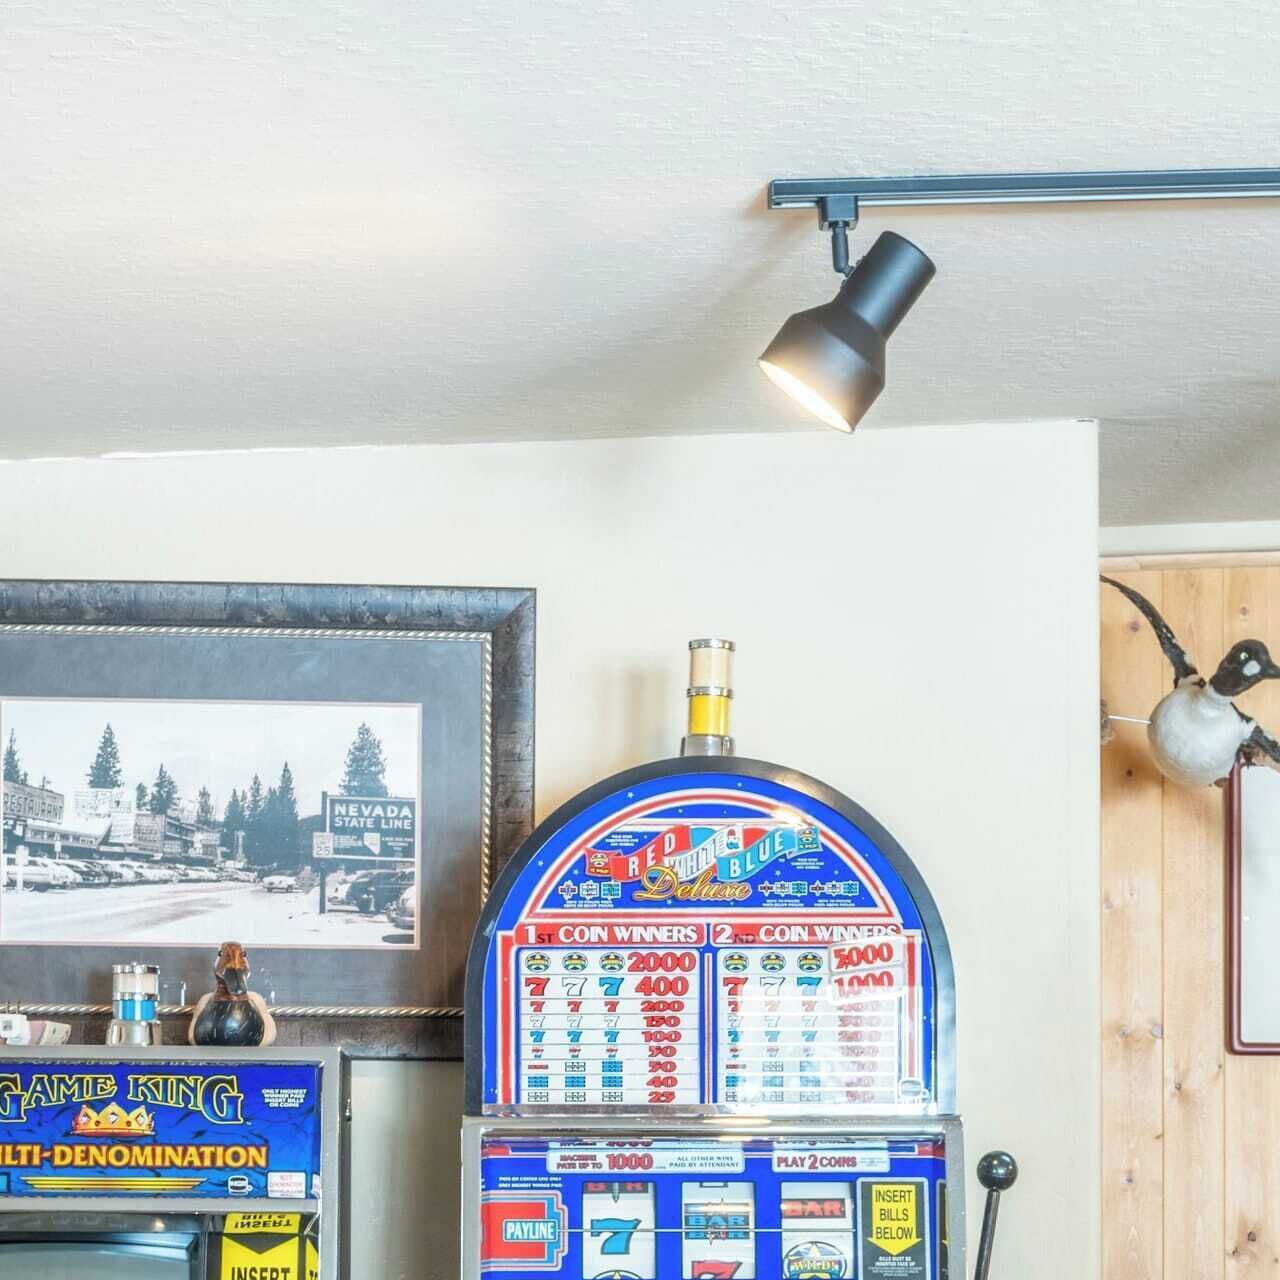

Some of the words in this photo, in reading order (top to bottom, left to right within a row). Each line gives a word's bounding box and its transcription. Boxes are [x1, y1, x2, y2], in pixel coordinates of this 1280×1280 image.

[333, 803, 413, 818] NEVADA
[333, 816, 375, 828] STATE
[381, 818, 413, 830] LINE
[628, 832, 677, 878] RED
[664, 832, 726, 879] WHITE
[730, 830, 785, 879] BLUE
[632, 864, 751, 901] Deluxe
[558, 925, 609, 943] COIN
[614, 925, 698, 943] WINNERS
[758, 925, 809, 943] COIN
[627, 952, 697, 972] 2000
[525, 976, 551, 997] 7
[562, 976, 588, 997] 7
[599, 976, 625, 997] 7
[635, 976, 690, 997] 400
[640, 1000, 685, 1013] 200
[642, 1015, 682, 1028] 150
[641, 1030, 683, 1043] 100
[646, 1075, 679, 1088] 40
[127, 1074, 245, 1126] KING
[648, 1090, 676, 1104] 25
[606, 1153, 654, 1170] 1000
[776, 1155, 806, 1168] PLAY
[808, 1153, 819, 1171] 2
[819, 1155, 858, 1168] COINS
[874, 1190, 913, 1203] INSERT
[688, 1215, 746, 1226] BAR
[879, 1208, 910, 1222] BILLS
[506, 1221, 555, 1240] PAYLINE
[590, 1217, 642, 1256] 7
[875, 1226, 914, 1240] BELOW
